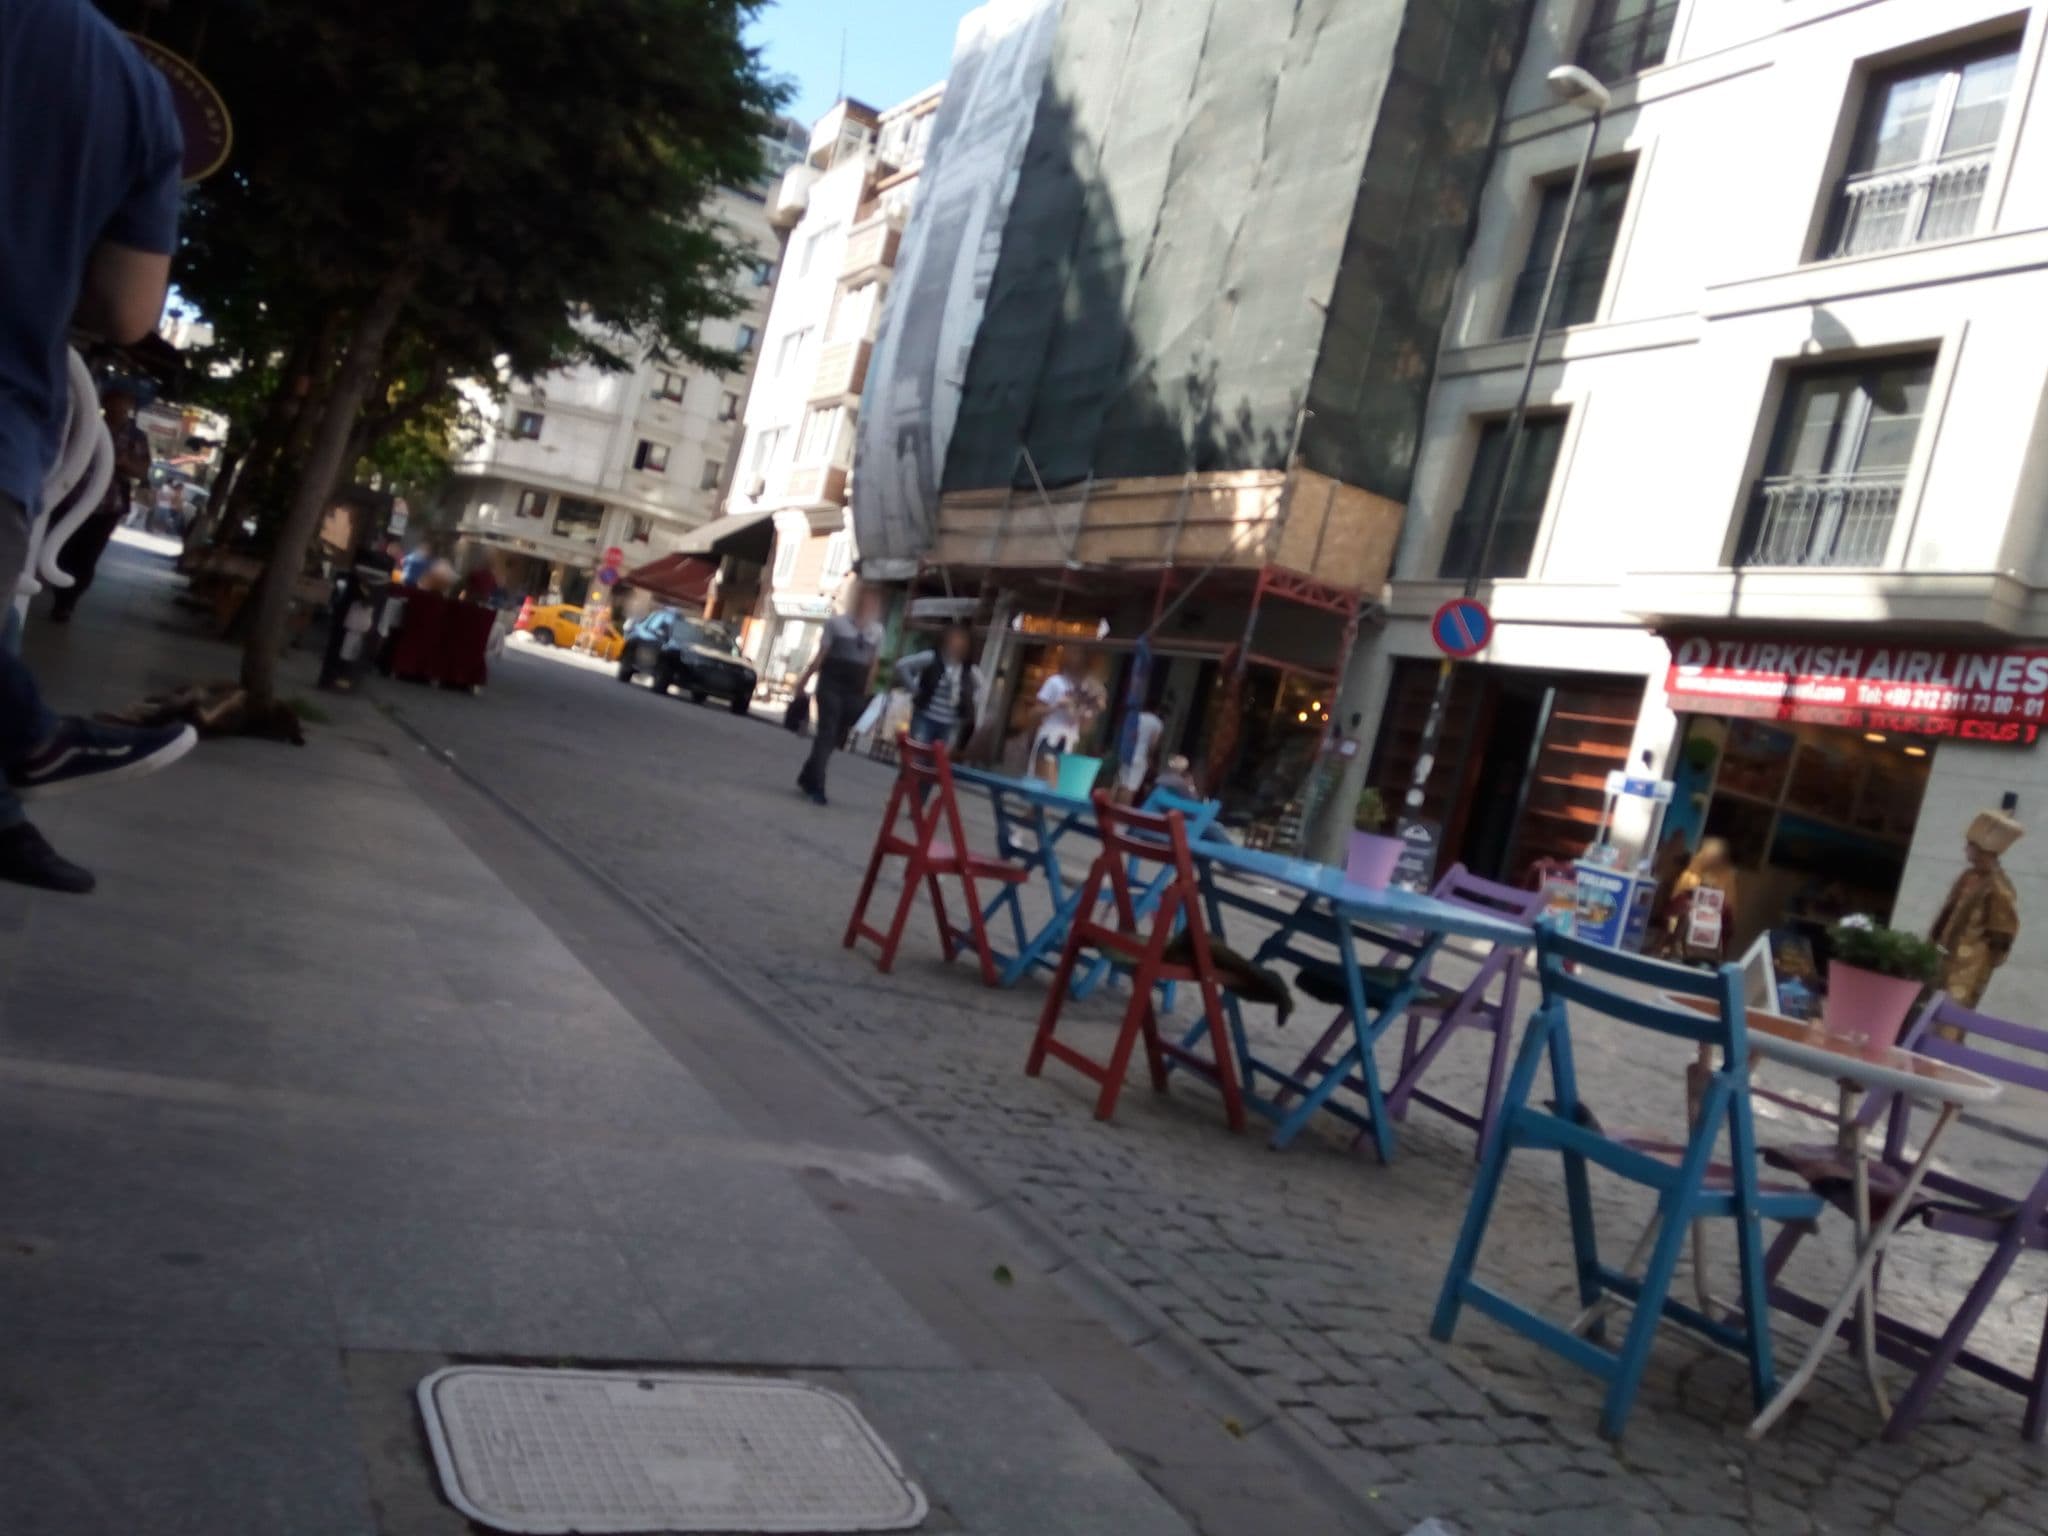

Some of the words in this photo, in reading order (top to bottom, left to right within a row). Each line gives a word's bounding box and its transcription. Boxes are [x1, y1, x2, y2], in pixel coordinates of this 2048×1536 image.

[1716, 640, 1864, 681] TURKISH
[1864, 650, 2048, 695] AIRLINES
[1857, 685, 1882, 704] Tel:
[1911, 689, 1940, 710] 212
[1941, 691, 1968, 711] 511
[1971, 694, 1991, 712] 73
[2024, 698, 2045, 717] 01
